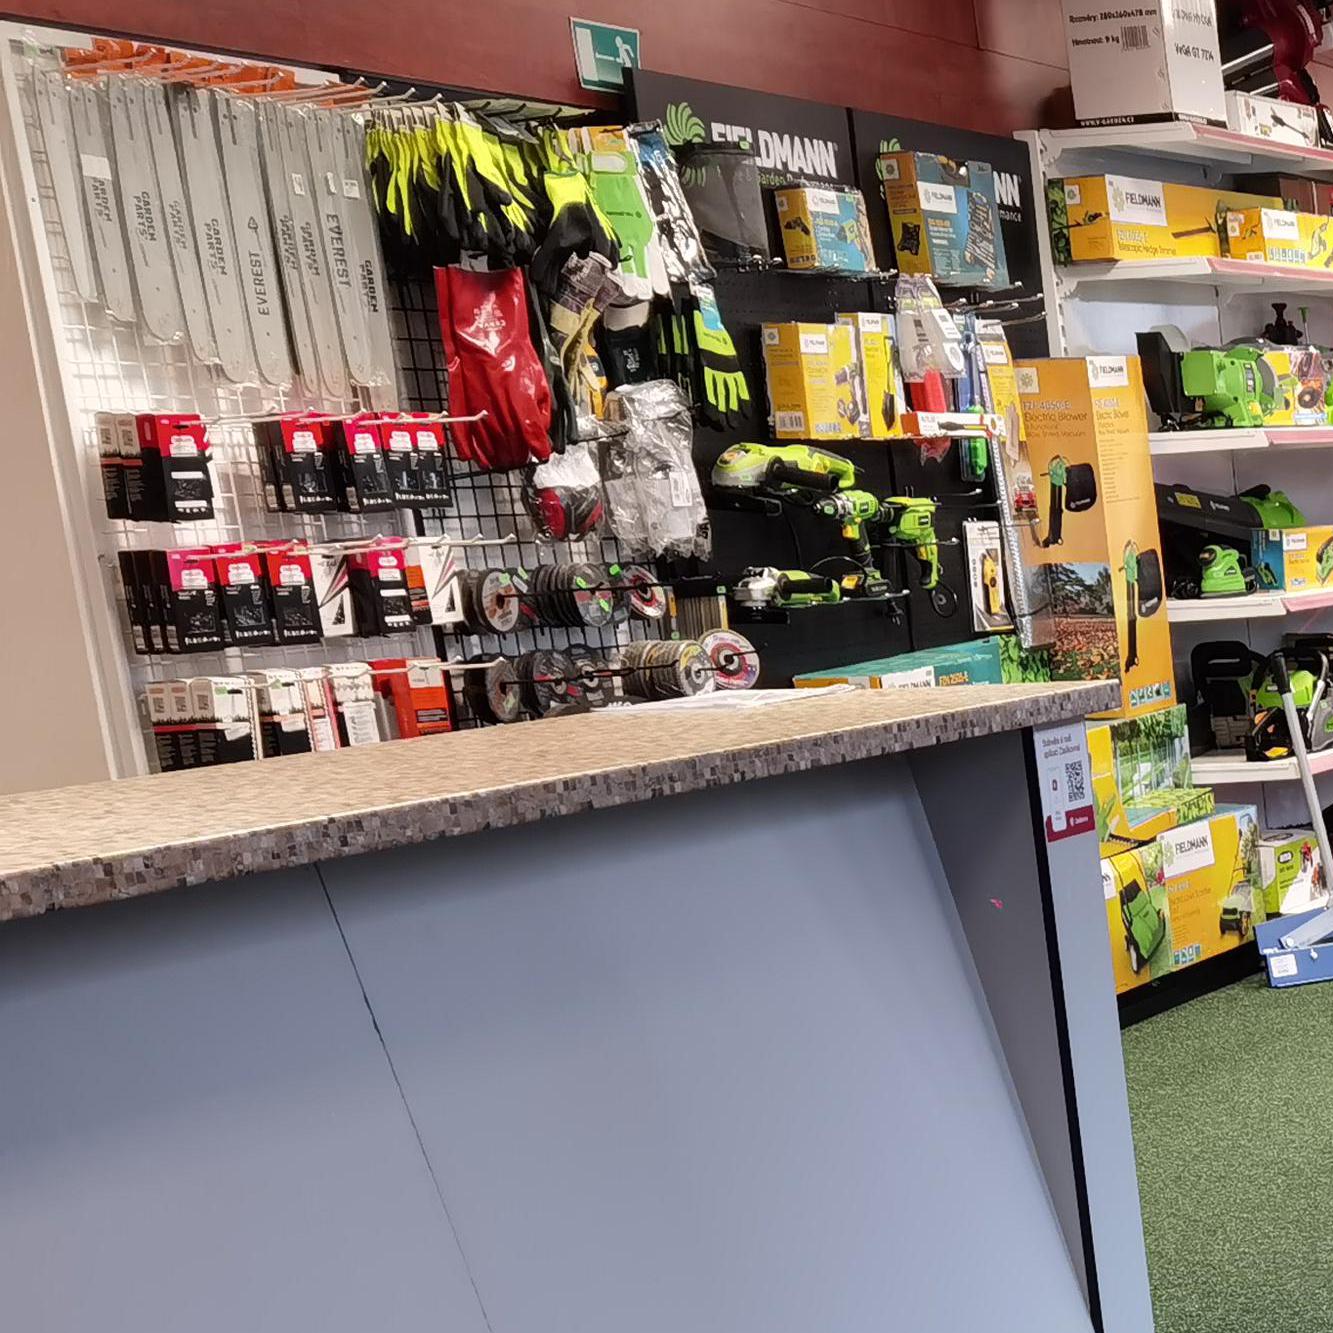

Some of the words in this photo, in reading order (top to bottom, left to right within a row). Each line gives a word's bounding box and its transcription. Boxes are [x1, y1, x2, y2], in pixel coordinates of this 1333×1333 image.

[141, 191, 157, 241] GARDEN
[1125, 192, 1162, 208] FIELDMANN
[211, 218, 227, 276] GARDEN
[326, 213, 352, 288] EVEREST
[250, 252, 270, 316] EVEREST
[365, 260, 379, 313] GARDEN
[1025, 411, 1057, 421] Electric
[1058, 411, 1088, 421] Blower
[1175, 837, 1209, 855] FIELDMANN
